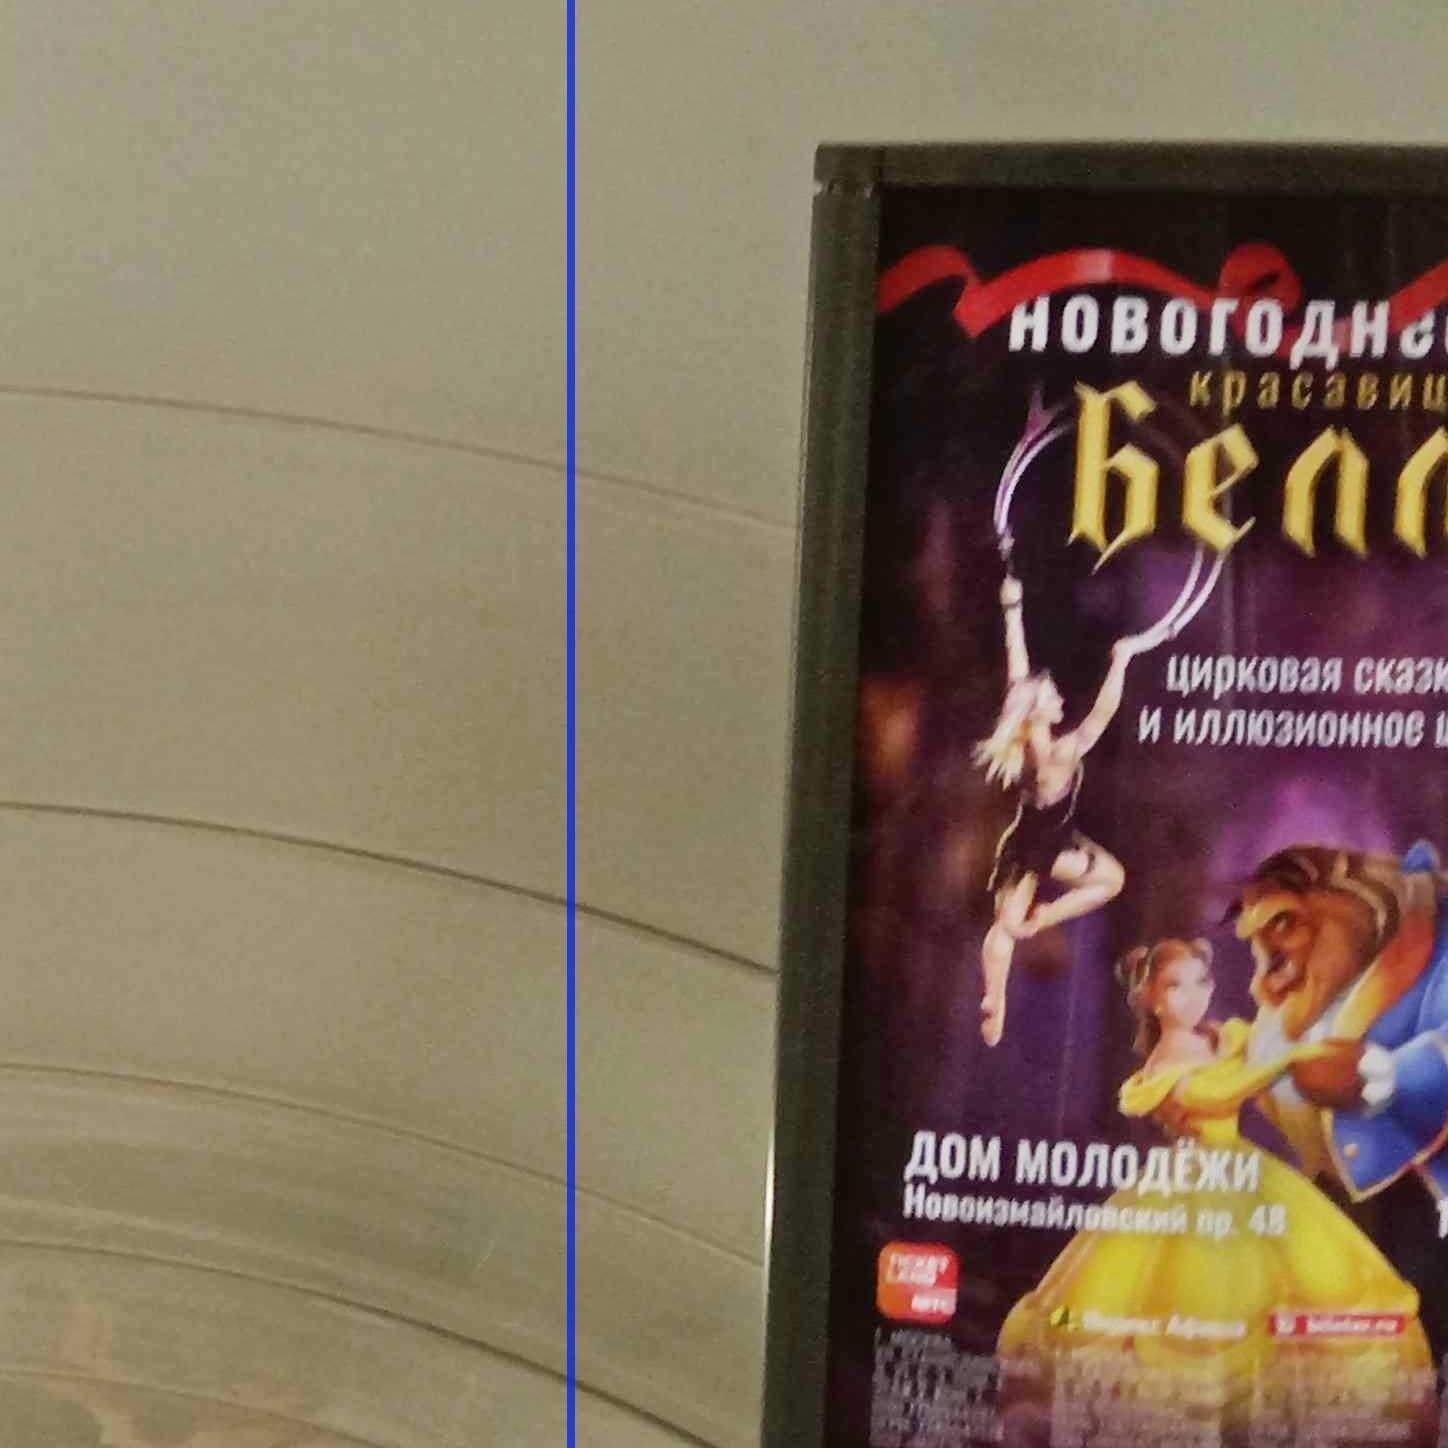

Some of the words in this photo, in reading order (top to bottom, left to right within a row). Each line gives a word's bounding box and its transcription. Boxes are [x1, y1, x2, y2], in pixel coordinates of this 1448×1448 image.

[1166, 654, 1343, 700] цирковая
[1173, 707, 1425, 749] иллюзионное
[904, 1130, 1002, 1186] ДОМ
[1016, 1136, 1263, 1198] МОЛОДЁЖИ
[903, 1182, 1187, 1234] Новоизмайловский
